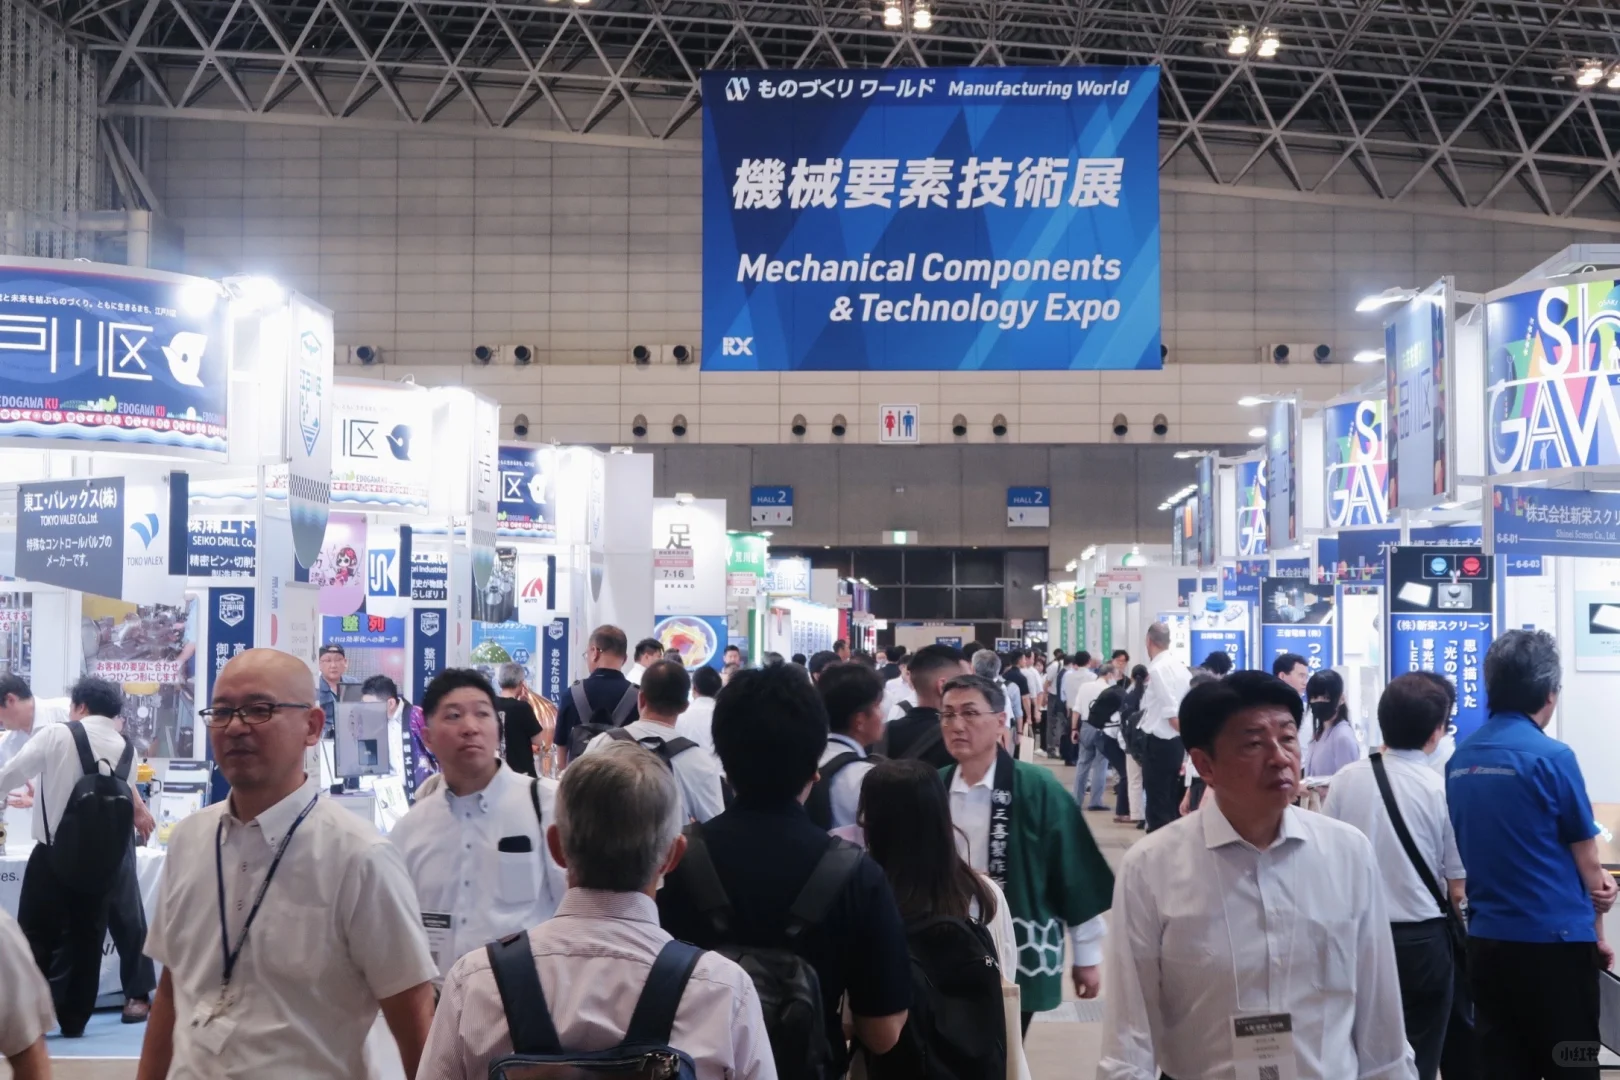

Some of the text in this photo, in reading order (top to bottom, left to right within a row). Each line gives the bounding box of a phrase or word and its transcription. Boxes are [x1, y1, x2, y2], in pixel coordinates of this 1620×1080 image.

[758, 79, 936, 98] ものづくり ワールド
[948, 80, 1130, 99] Manufacturing World
[733, 157, 1125, 209] 機械要素技術展
[737, 253, 1121, 288] Mechanical Components
[830, 292, 1121, 329] & Technology Expo
[722, 336, 754, 356] RX
[757, 490, 787, 504] HALL 2
[1013, 491, 1043, 504] HALL 2
[40, 514, 59, 527] TOKYO
[60, 514, 78, 526] VALEX
[193, 536, 215, 546] SEIKO
[218, 537, 239, 547] DRILL
[1497, 534, 1519, 544] 6-6-01
[1575, 531, 1594, 540] Screen
[26, 535, 113, 552] 特殊なコントロールバルブの
[46, 553, 89, 567] メーカーです。
[127, 556, 143, 566] TOKO
[1516, 560, 1540, 568] 6-6-03
[96, 661, 180, 672] お客様の要望に合わせ
[1463, 638, 1477, 708] 思い描いた
